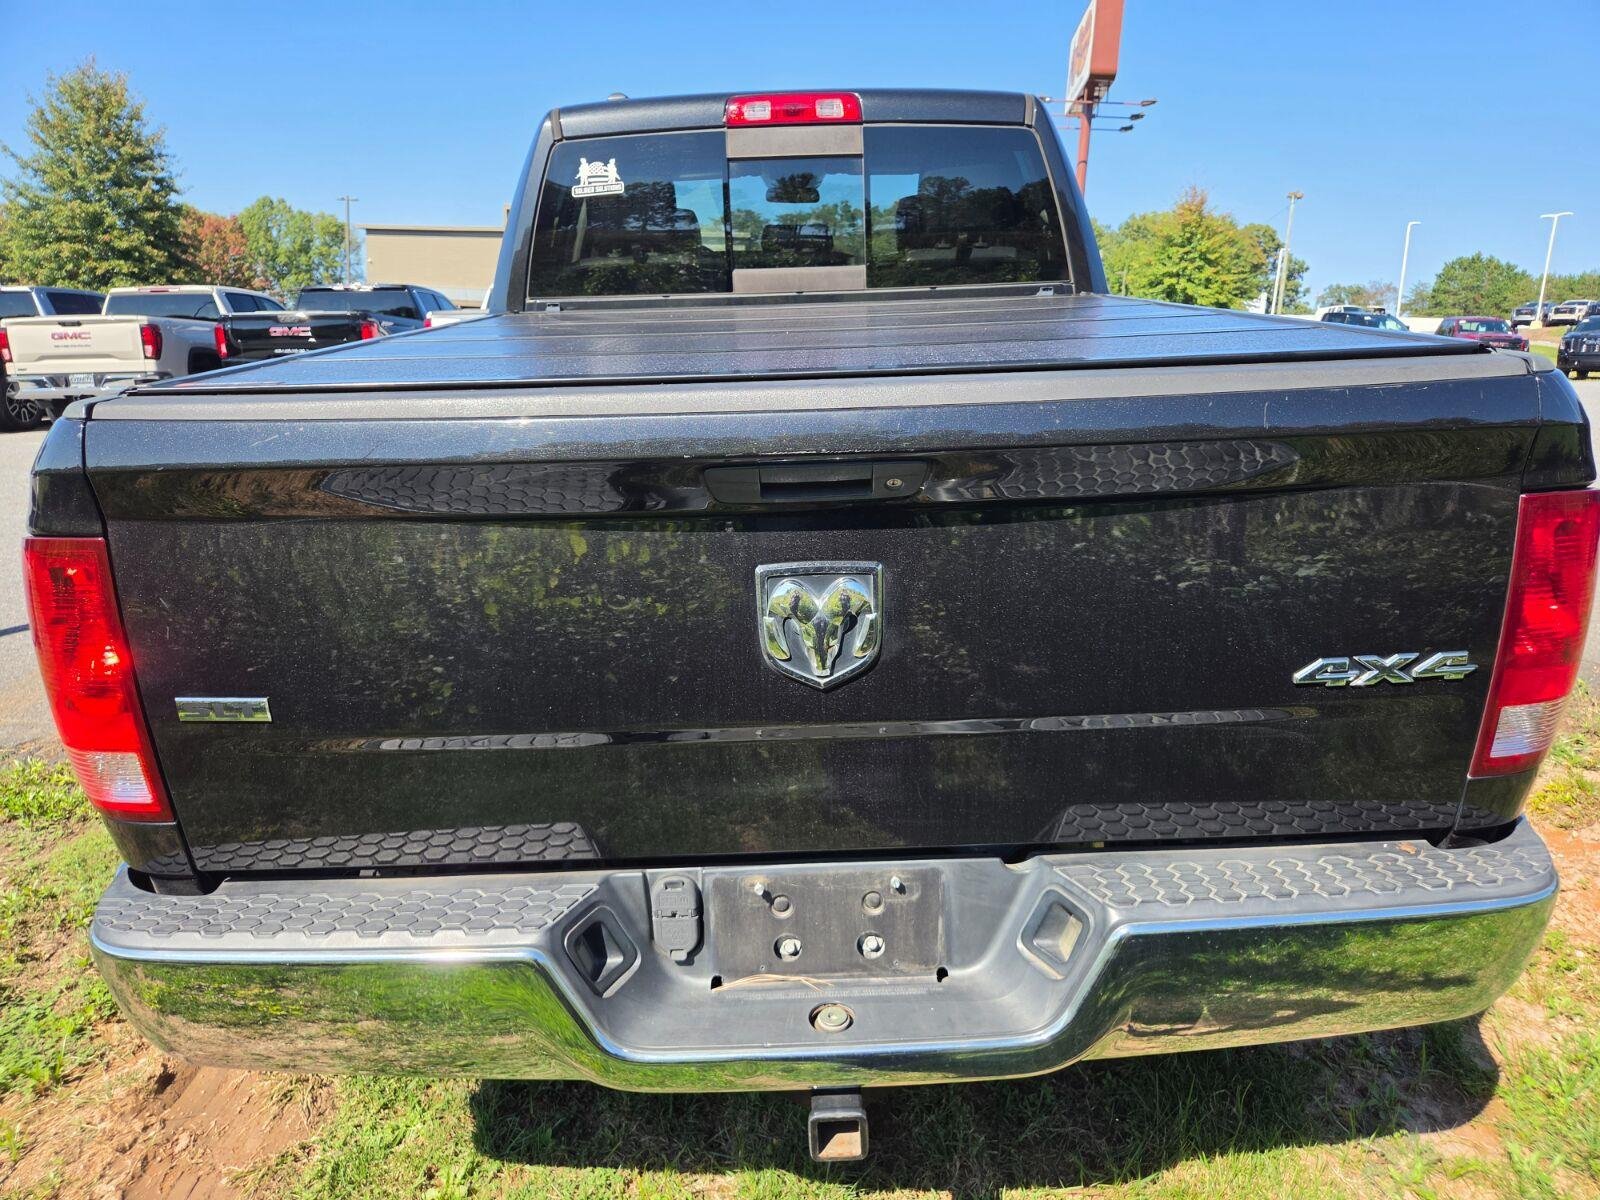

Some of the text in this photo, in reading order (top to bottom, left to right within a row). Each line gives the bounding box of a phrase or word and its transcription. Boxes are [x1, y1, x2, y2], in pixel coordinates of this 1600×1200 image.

[51, 331, 92, 341] GMC
[269, 326, 312, 336] GMC
[175, 697, 272, 722] SLT
